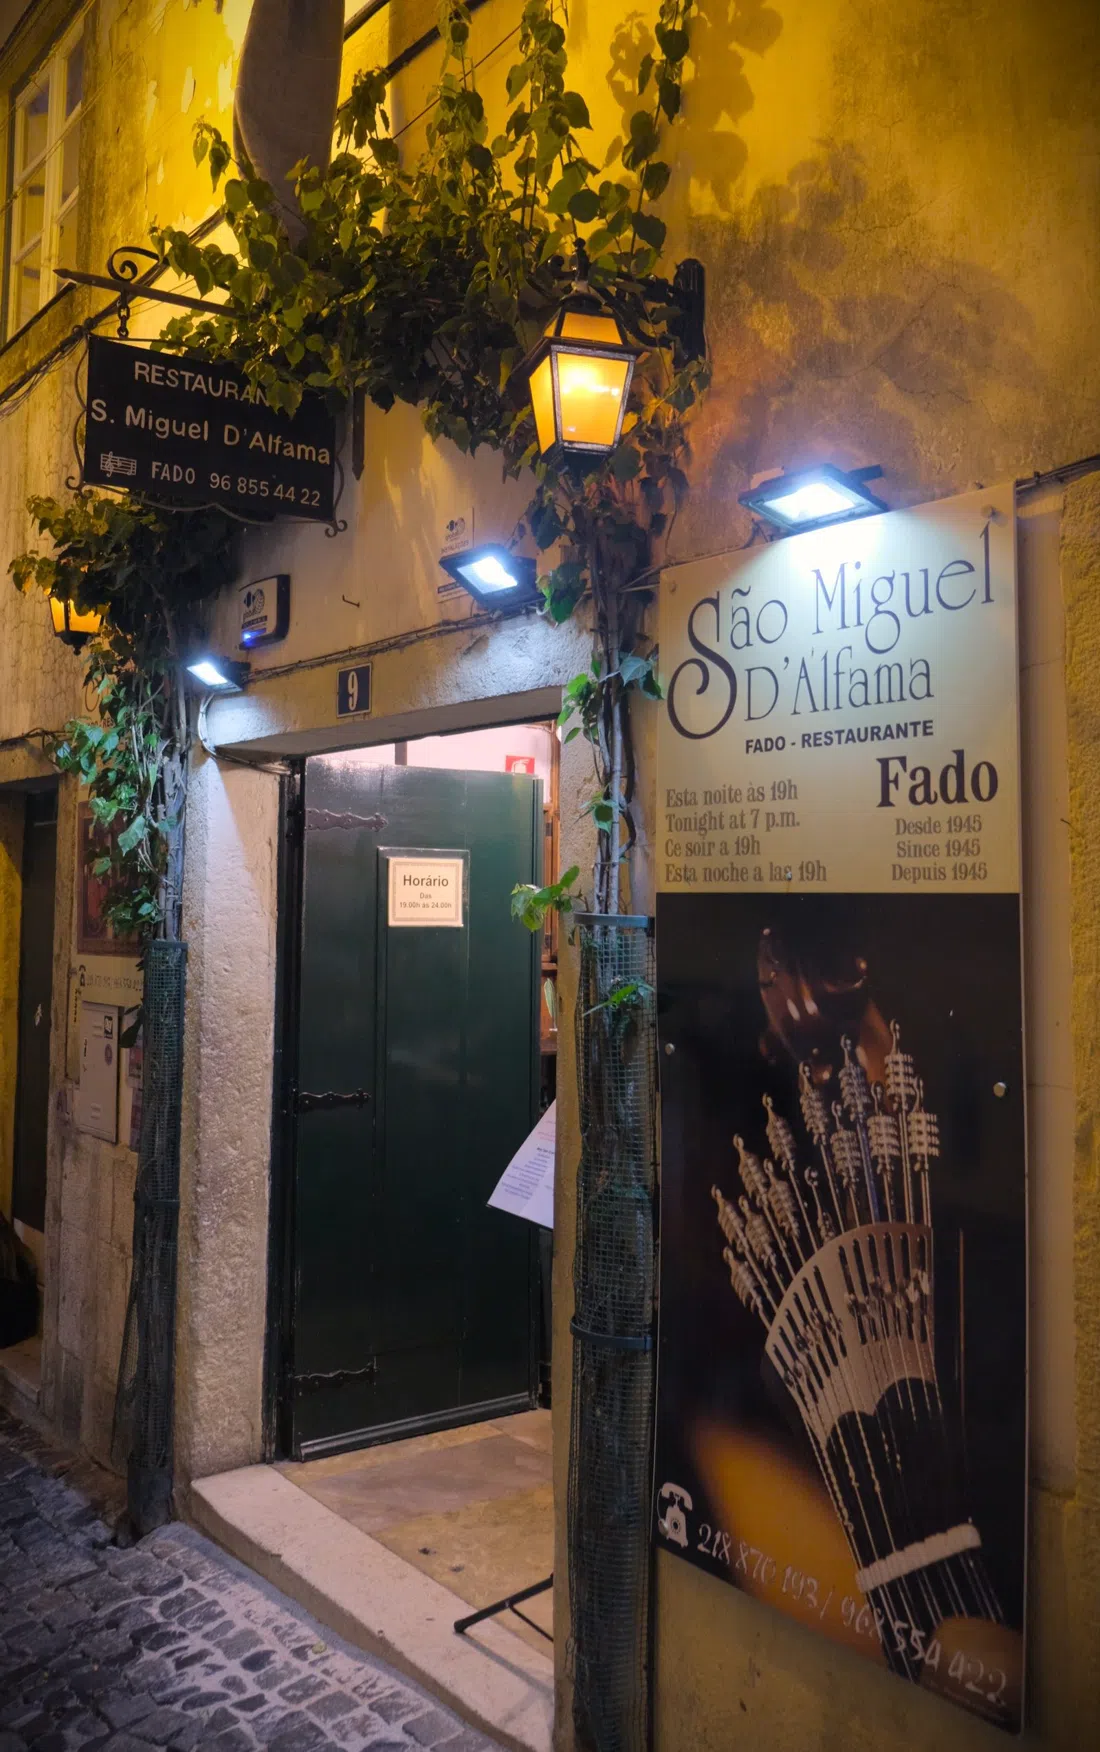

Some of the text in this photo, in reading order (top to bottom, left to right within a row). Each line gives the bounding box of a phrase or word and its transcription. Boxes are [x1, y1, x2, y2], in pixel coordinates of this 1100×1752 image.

[134, 361, 269, 407] RESTAURAN
[91, 398, 331, 465] S. Miguel D'Alfama
[151, 461, 321, 507] FADO 96 855 44 22
[667, 521, 995, 740] São Miguel
[347, 671, 359, 711] 9
[744, 645, 935, 722] D'Alfama
[745, 735, 786, 754] FADO
[801, 719, 934, 749] RESTAURANTE
[666, 779, 798, 808] Esta noite às 19h
[876, 749, 998, 808] Fado
[665, 808, 800, 836] Tonight at 7 p.m.
[895, 814, 982, 835] Desde 1945
[665, 834, 760, 857] Ce soir a 19h
[897, 838, 981, 858] Since 1945
[403, 874, 448, 887] Horário
[665, 860, 827, 883] Esta noche a las 19h
[891, 861, 988, 884] Depuis 1945
[697, 1524, 731, 1564] 218
[782, 1566, 818, 1608] 193
[893, 1620, 942, 1670] 554
[948, 1651, 1006, 1706] 422
